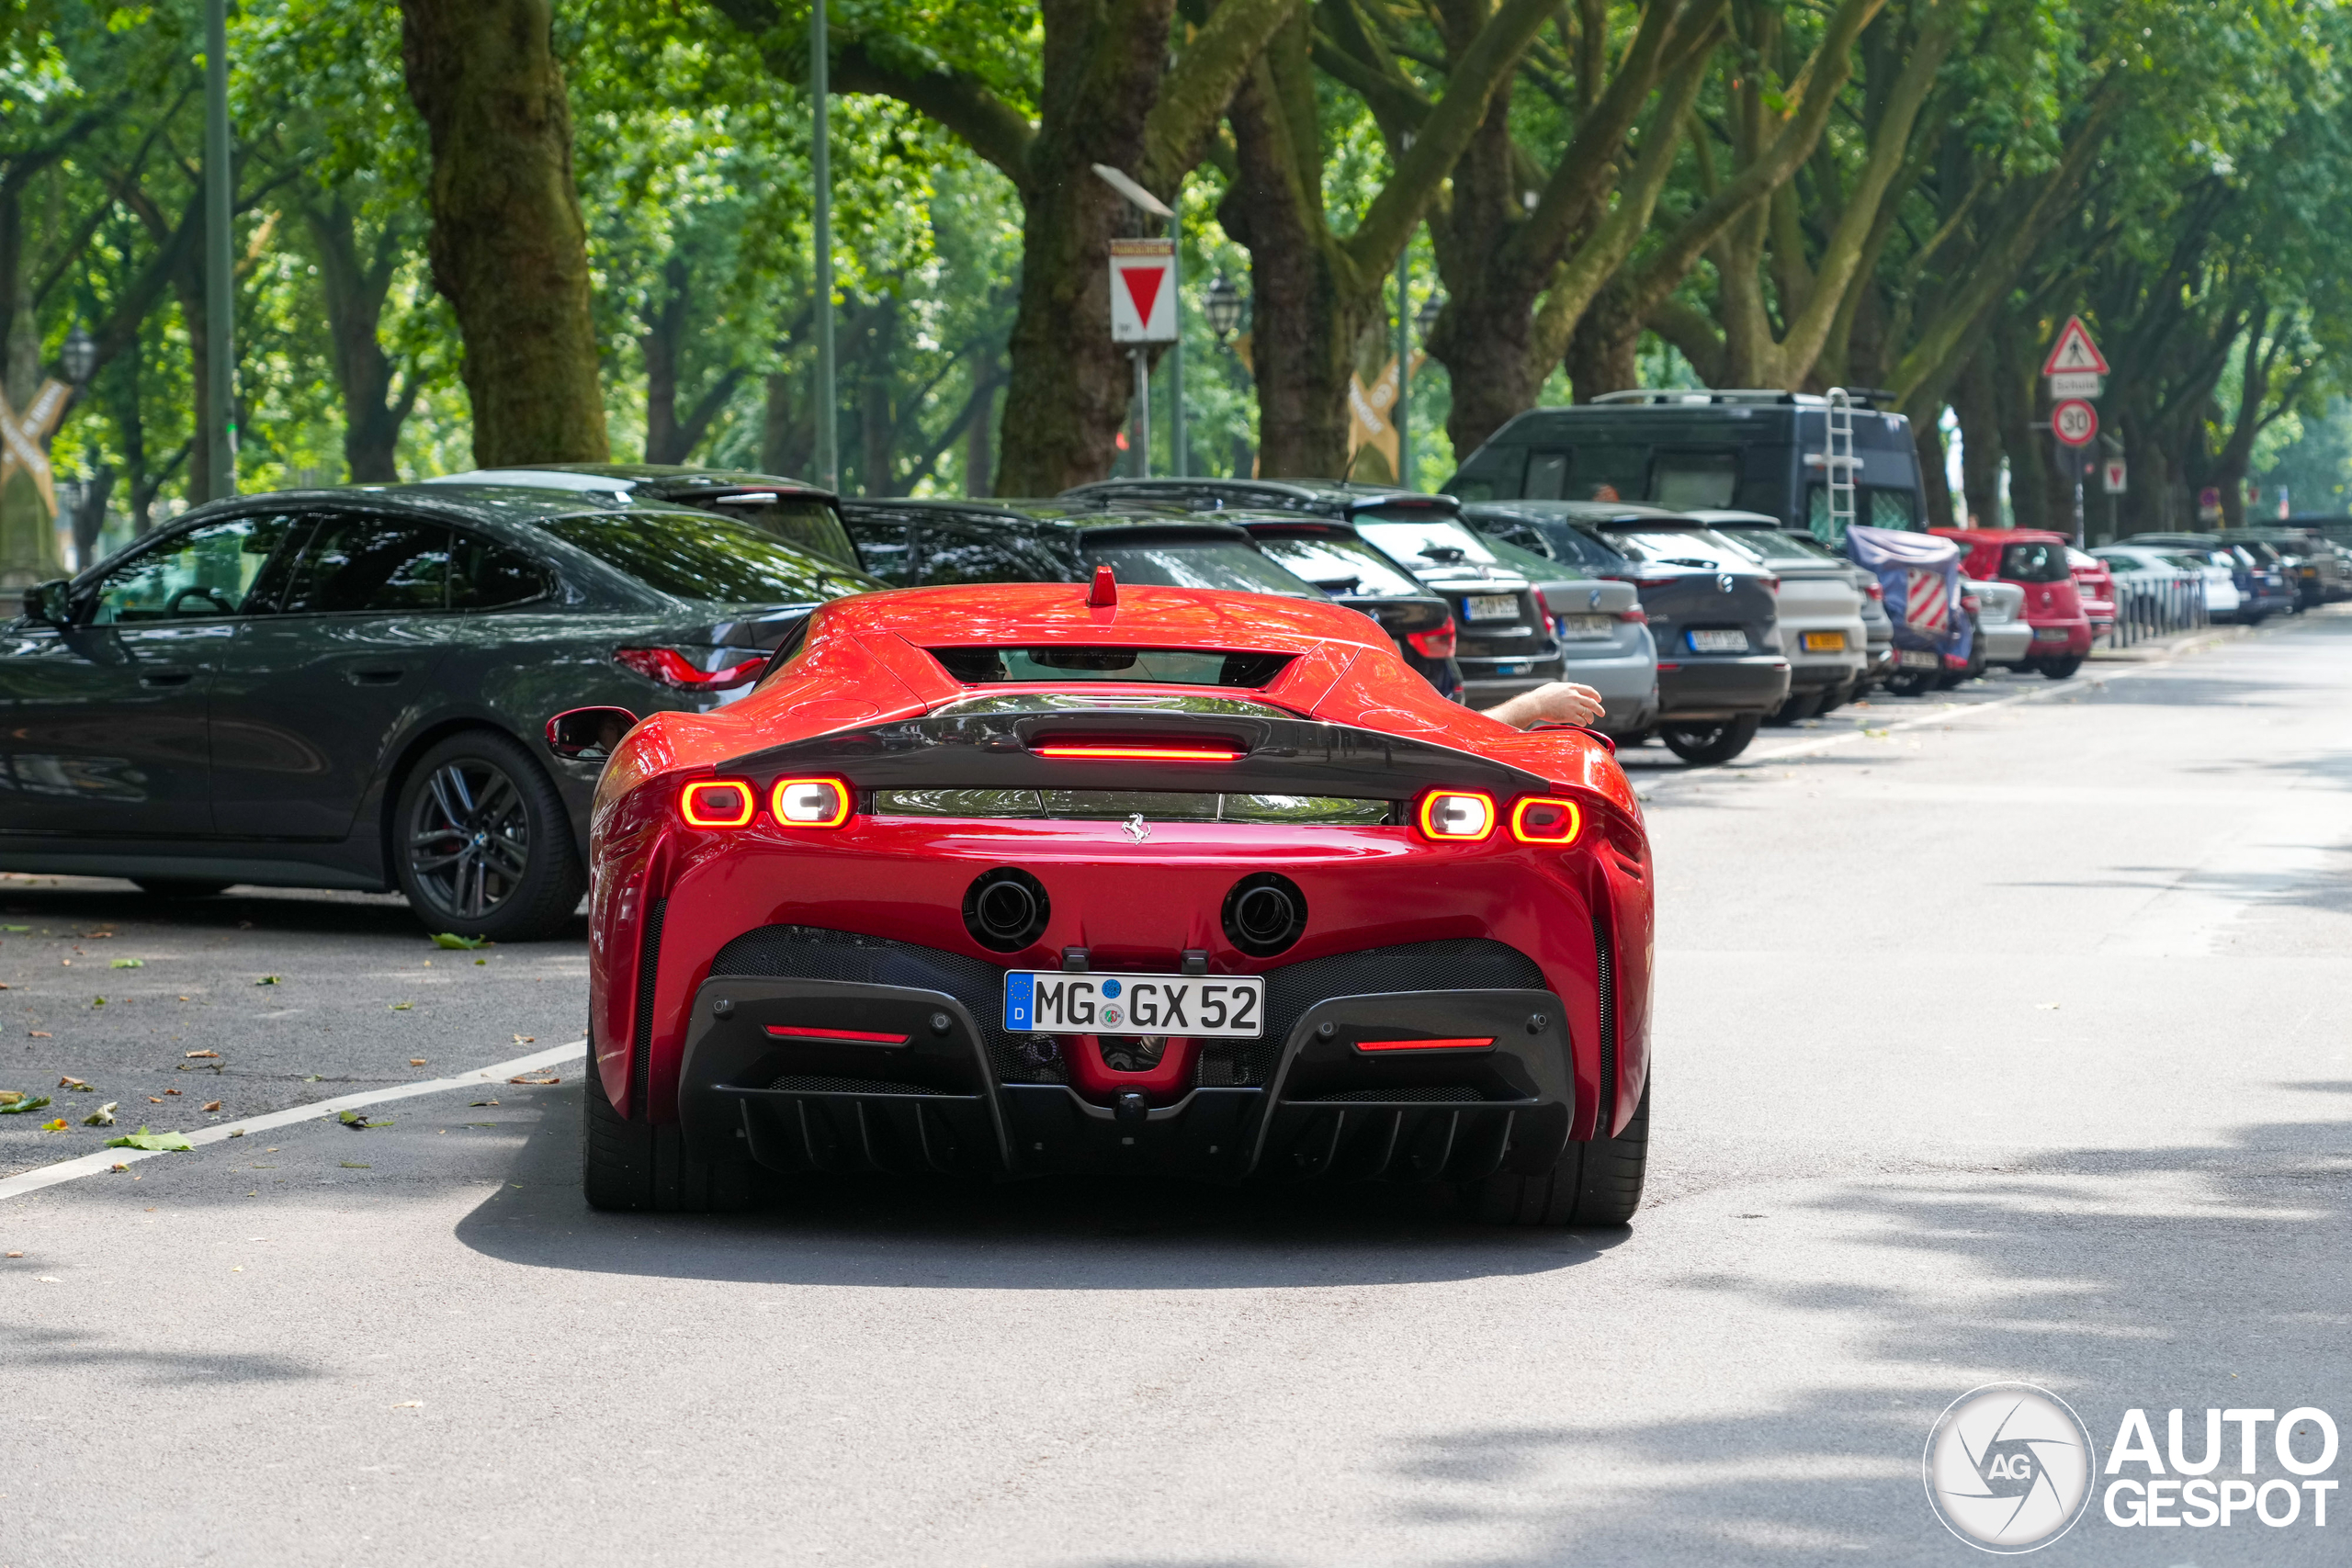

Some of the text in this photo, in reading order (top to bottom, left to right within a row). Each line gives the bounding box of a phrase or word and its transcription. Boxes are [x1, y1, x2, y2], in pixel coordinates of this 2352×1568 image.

[2056, 379, 2097, 391] Schule
[2063, 411, 2087, 432] 30
[1014, 1007, 1024, 1021] D
[1035, 981, 1095, 1025] MG
[1129, 983, 1189, 1028] GX
[1200, 985, 1257, 1029] 52
